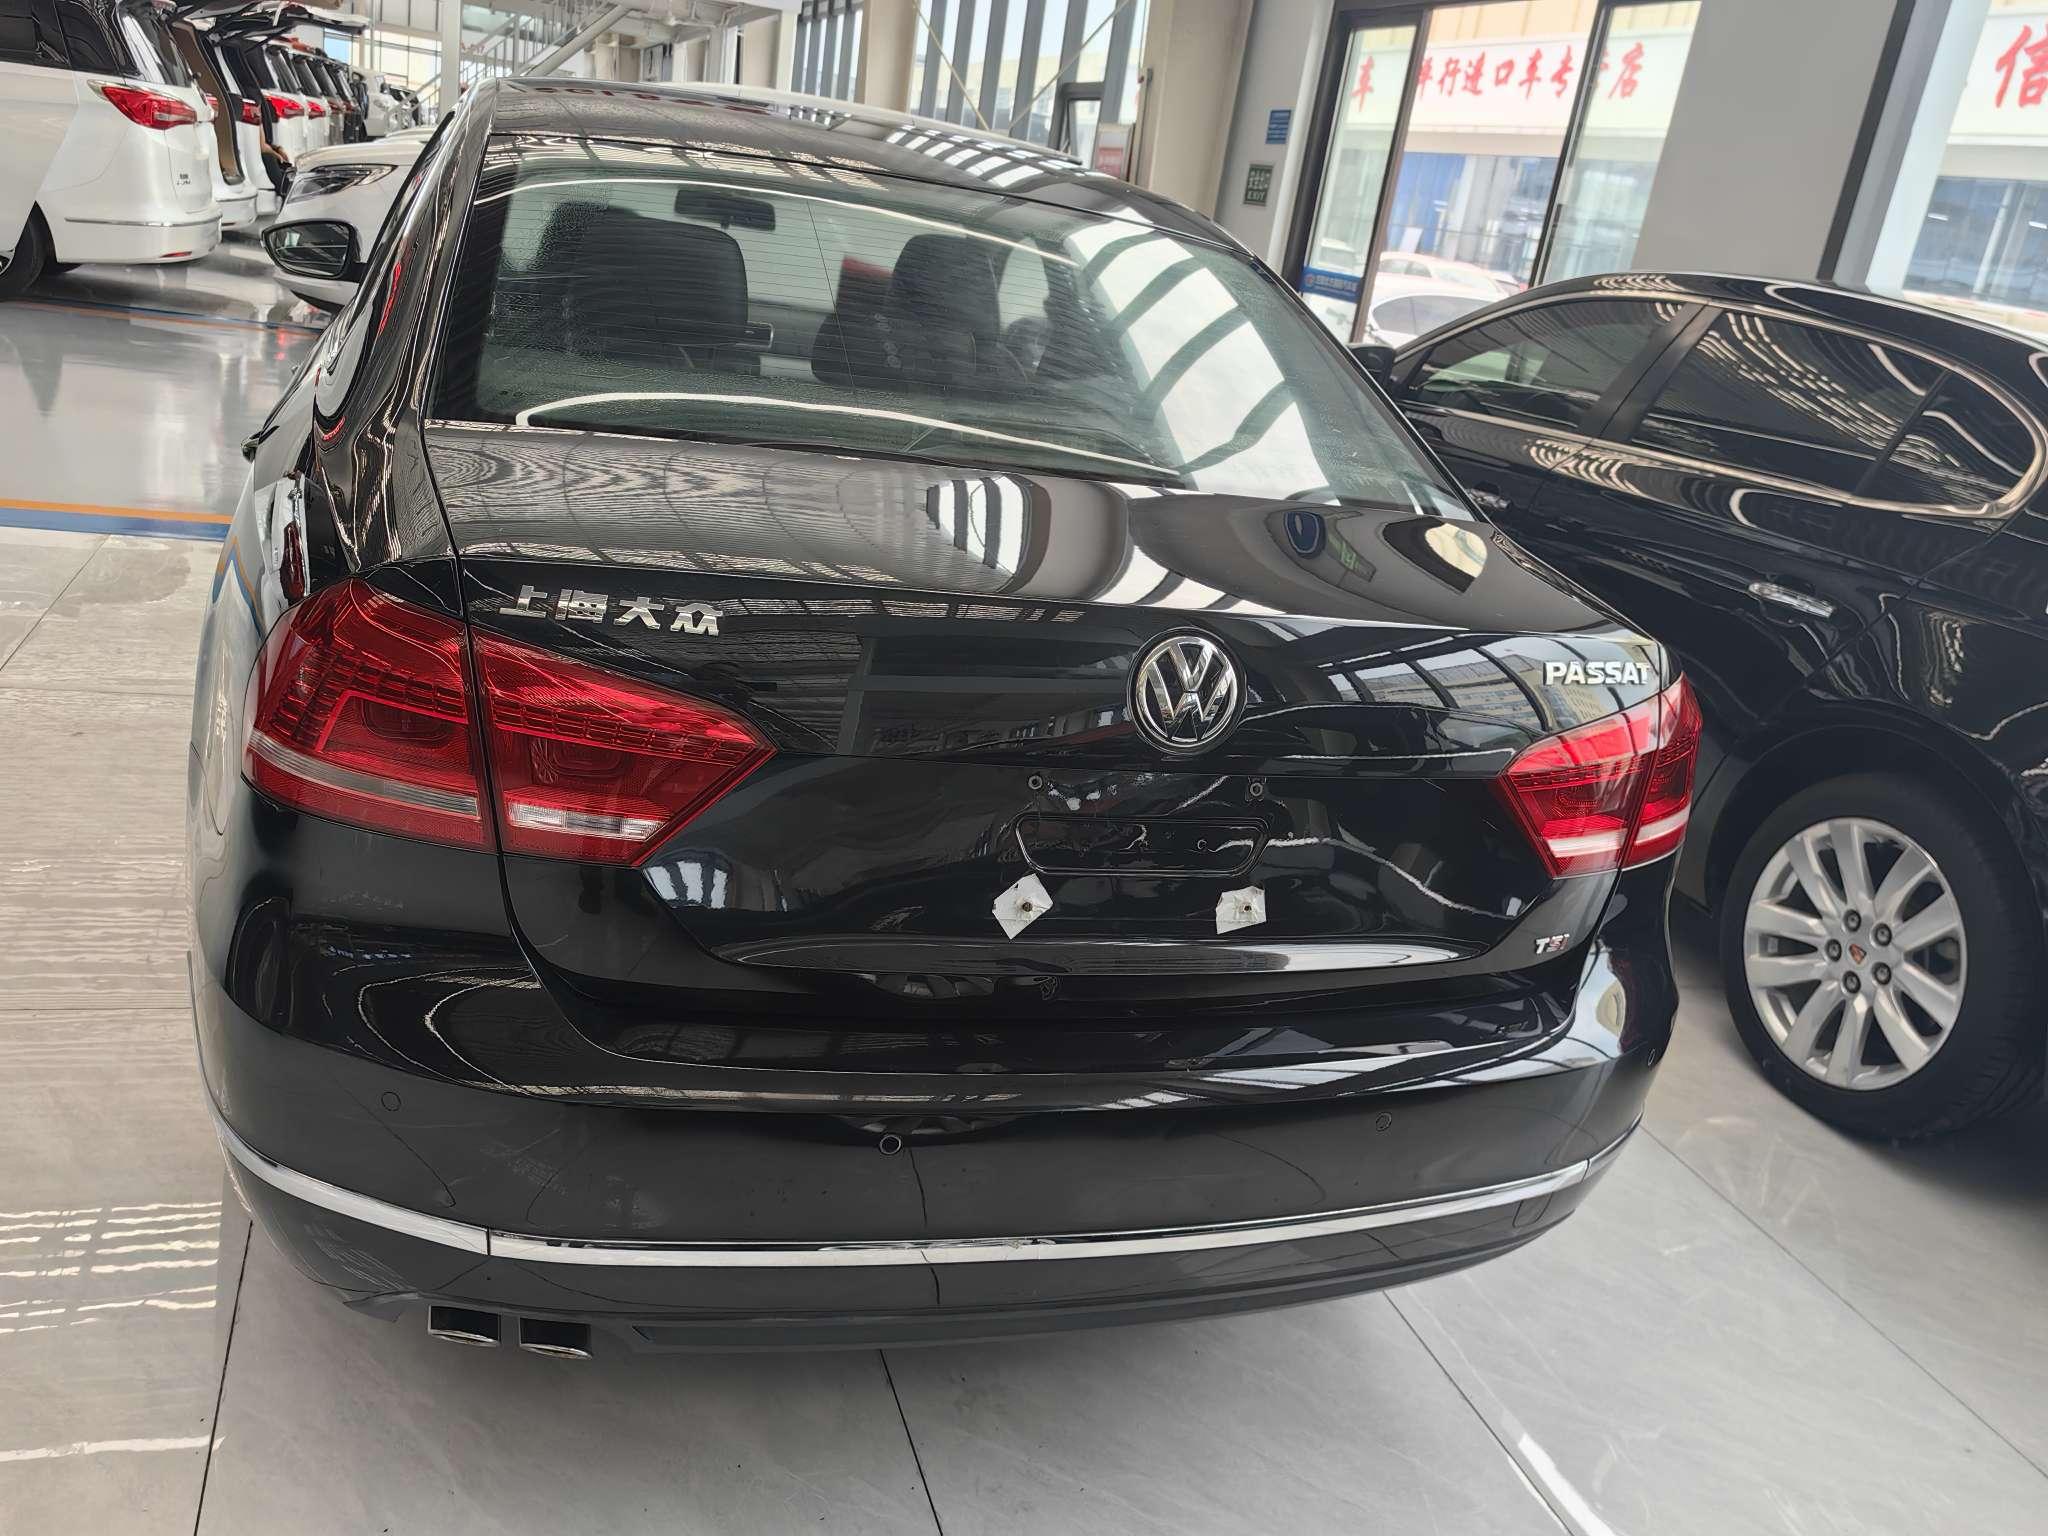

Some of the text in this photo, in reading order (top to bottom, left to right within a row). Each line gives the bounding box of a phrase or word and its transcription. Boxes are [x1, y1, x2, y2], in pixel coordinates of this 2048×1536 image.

[499, 584, 724, 637] 上海大众
[1543, 660, 1651, 686] PASSAT
